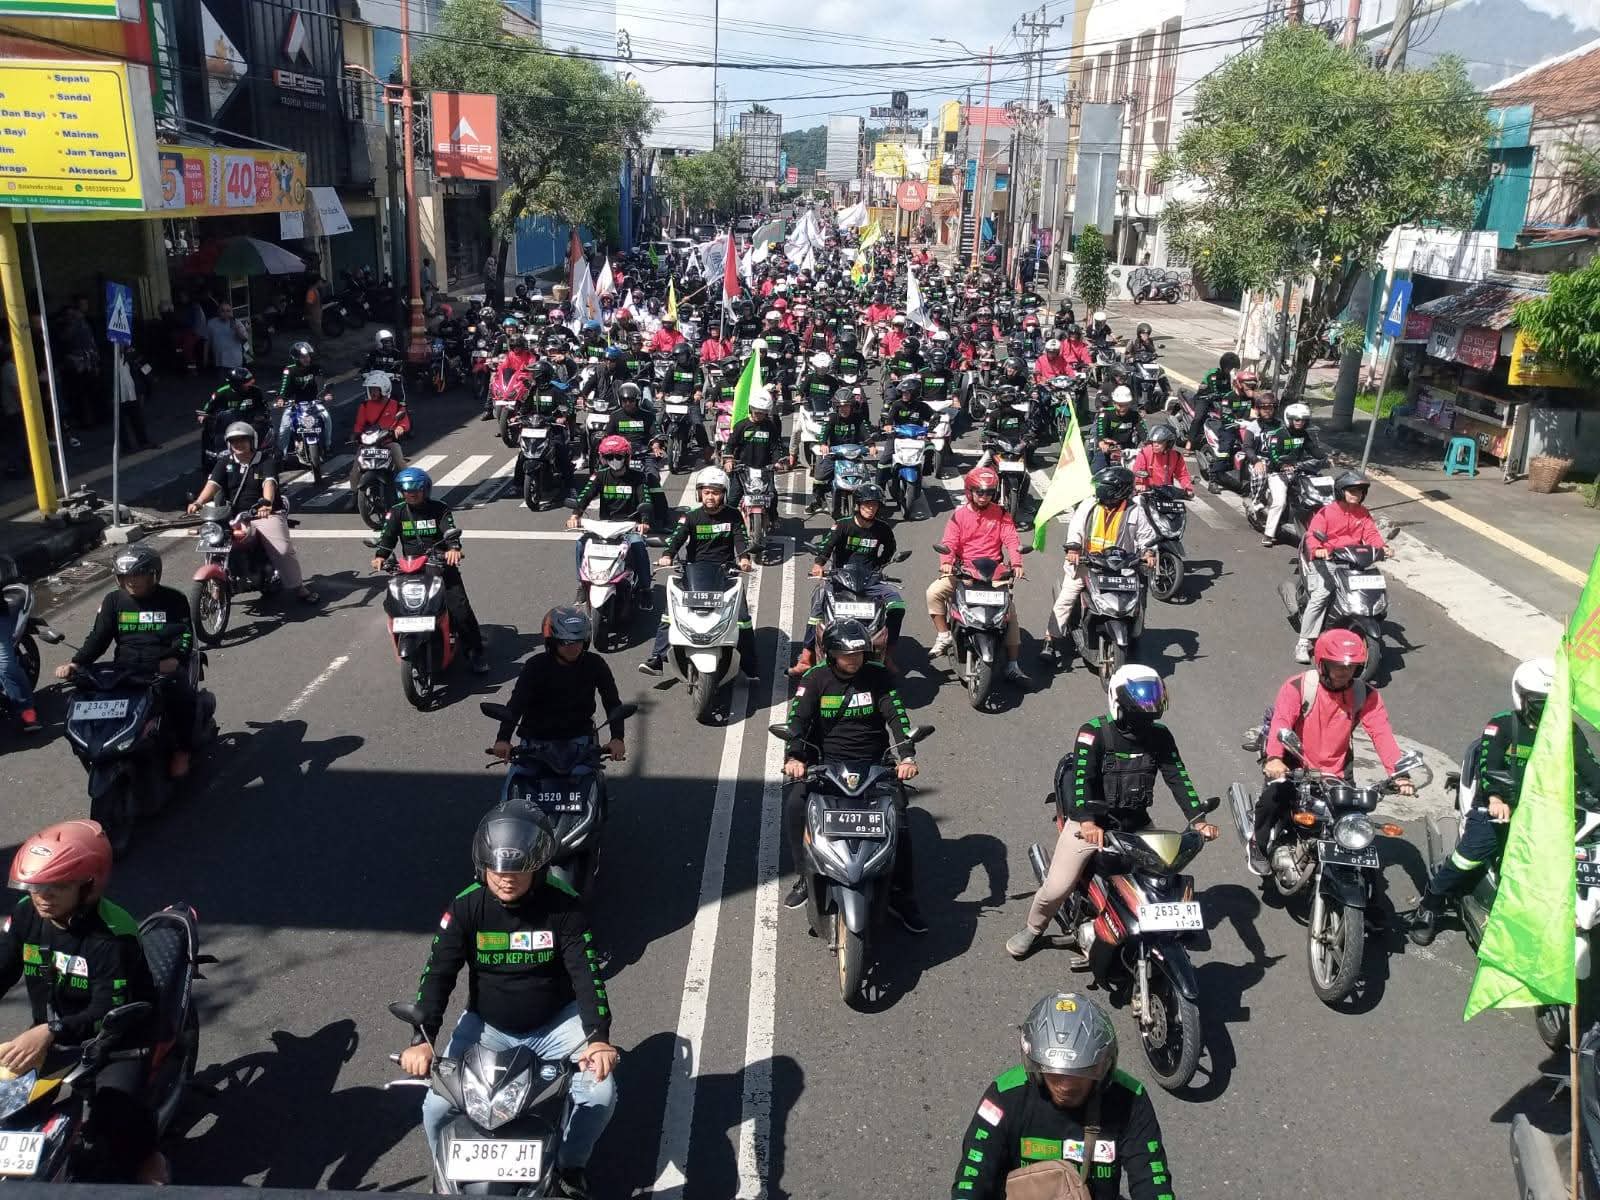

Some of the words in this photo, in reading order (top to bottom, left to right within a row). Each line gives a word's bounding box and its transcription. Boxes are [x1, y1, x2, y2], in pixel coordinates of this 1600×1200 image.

[54, 74, 90, 84] Sepatu
[57, 93, 91, 102] Sandal
[23, 110, 45, 119] Bayi
[4, 128, 27, 137] Bayi
[62, 130, 99, 139] Mainan
[438, 143, 492, 153] EIGER
[65, 149, 87, 157] Jam
[90, 149, 127, 159] Tangan
[68, 166, 117, 176] Aksesoris
[228, 163, 252, 198] 40
[538, 792, 562, 801] 3520
[826, 813, 832, 823] R
[839, 813, 862, 823] 4737
[1155, 905, 1180, 917] 2635
[492, 952, 504, 965] SP
[506, 952, 522, 964] KEP
[19, 1136, 40, 1152] DK
[452, 1143, 461, 1160] R
[471, 1143, 508, 1160] 3867
[519, 1144, 537, 1160] HT
